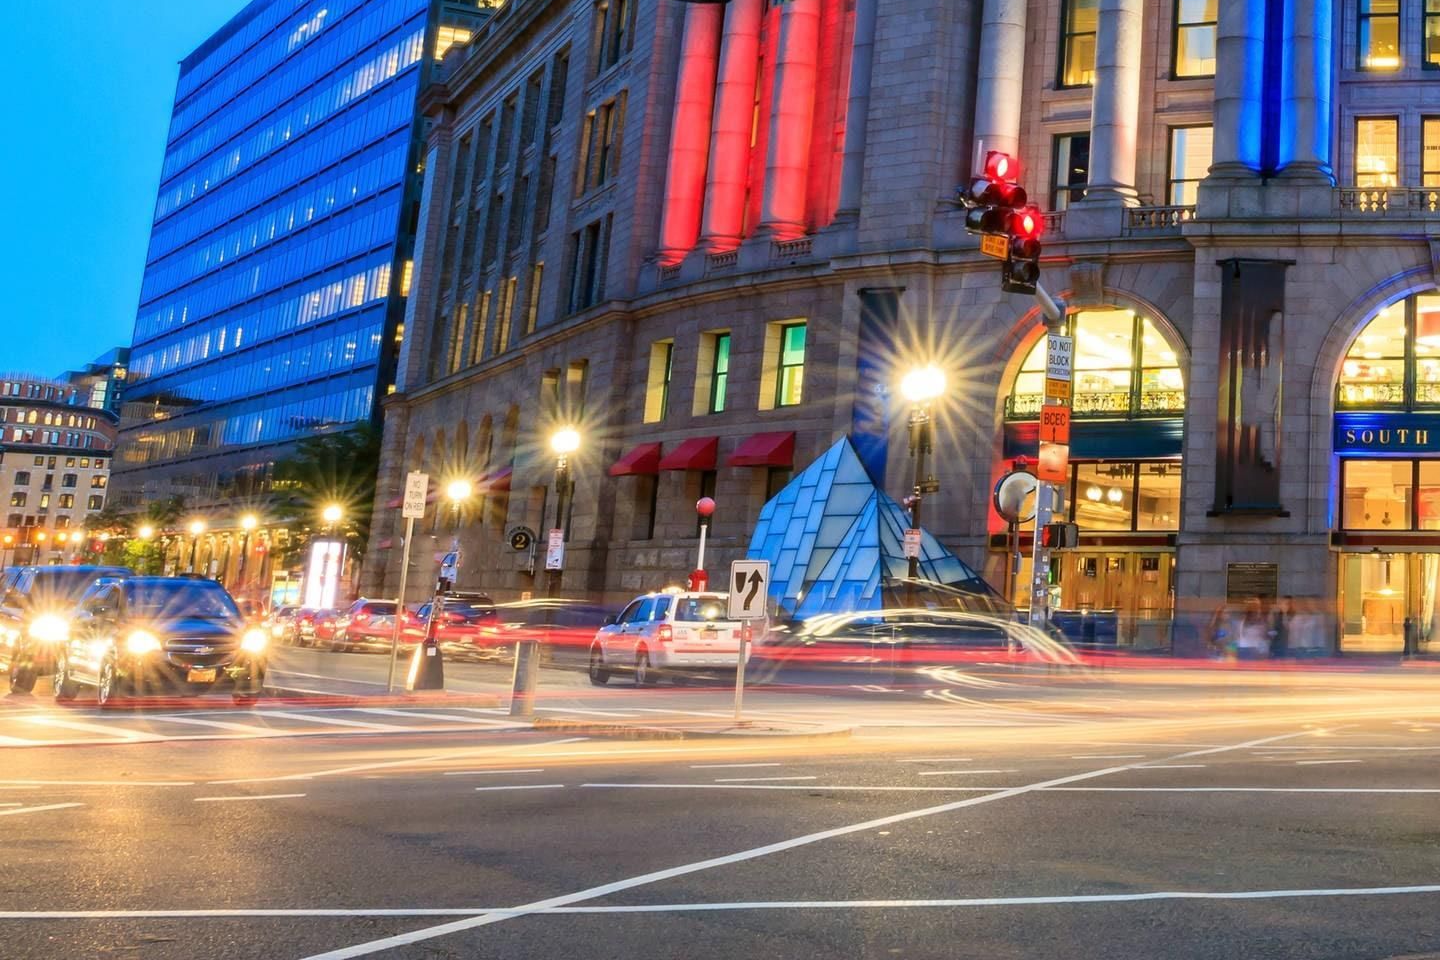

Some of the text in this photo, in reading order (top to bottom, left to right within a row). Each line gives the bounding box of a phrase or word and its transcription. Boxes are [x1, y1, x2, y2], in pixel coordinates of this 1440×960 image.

[1048, 340, 1072, 352] DO NOT
[1049, 354, 1070, 366] BLOCK
[1044, 413, 1066, 426] BCEC
[1346, 429, 1429, 445] SOUTH
[413, 480, 422, 489] NO
[409, 490, 423, 500] TURN
[405, 502, 424, 511] ON RED
[515, 534, 525, 548] 2
